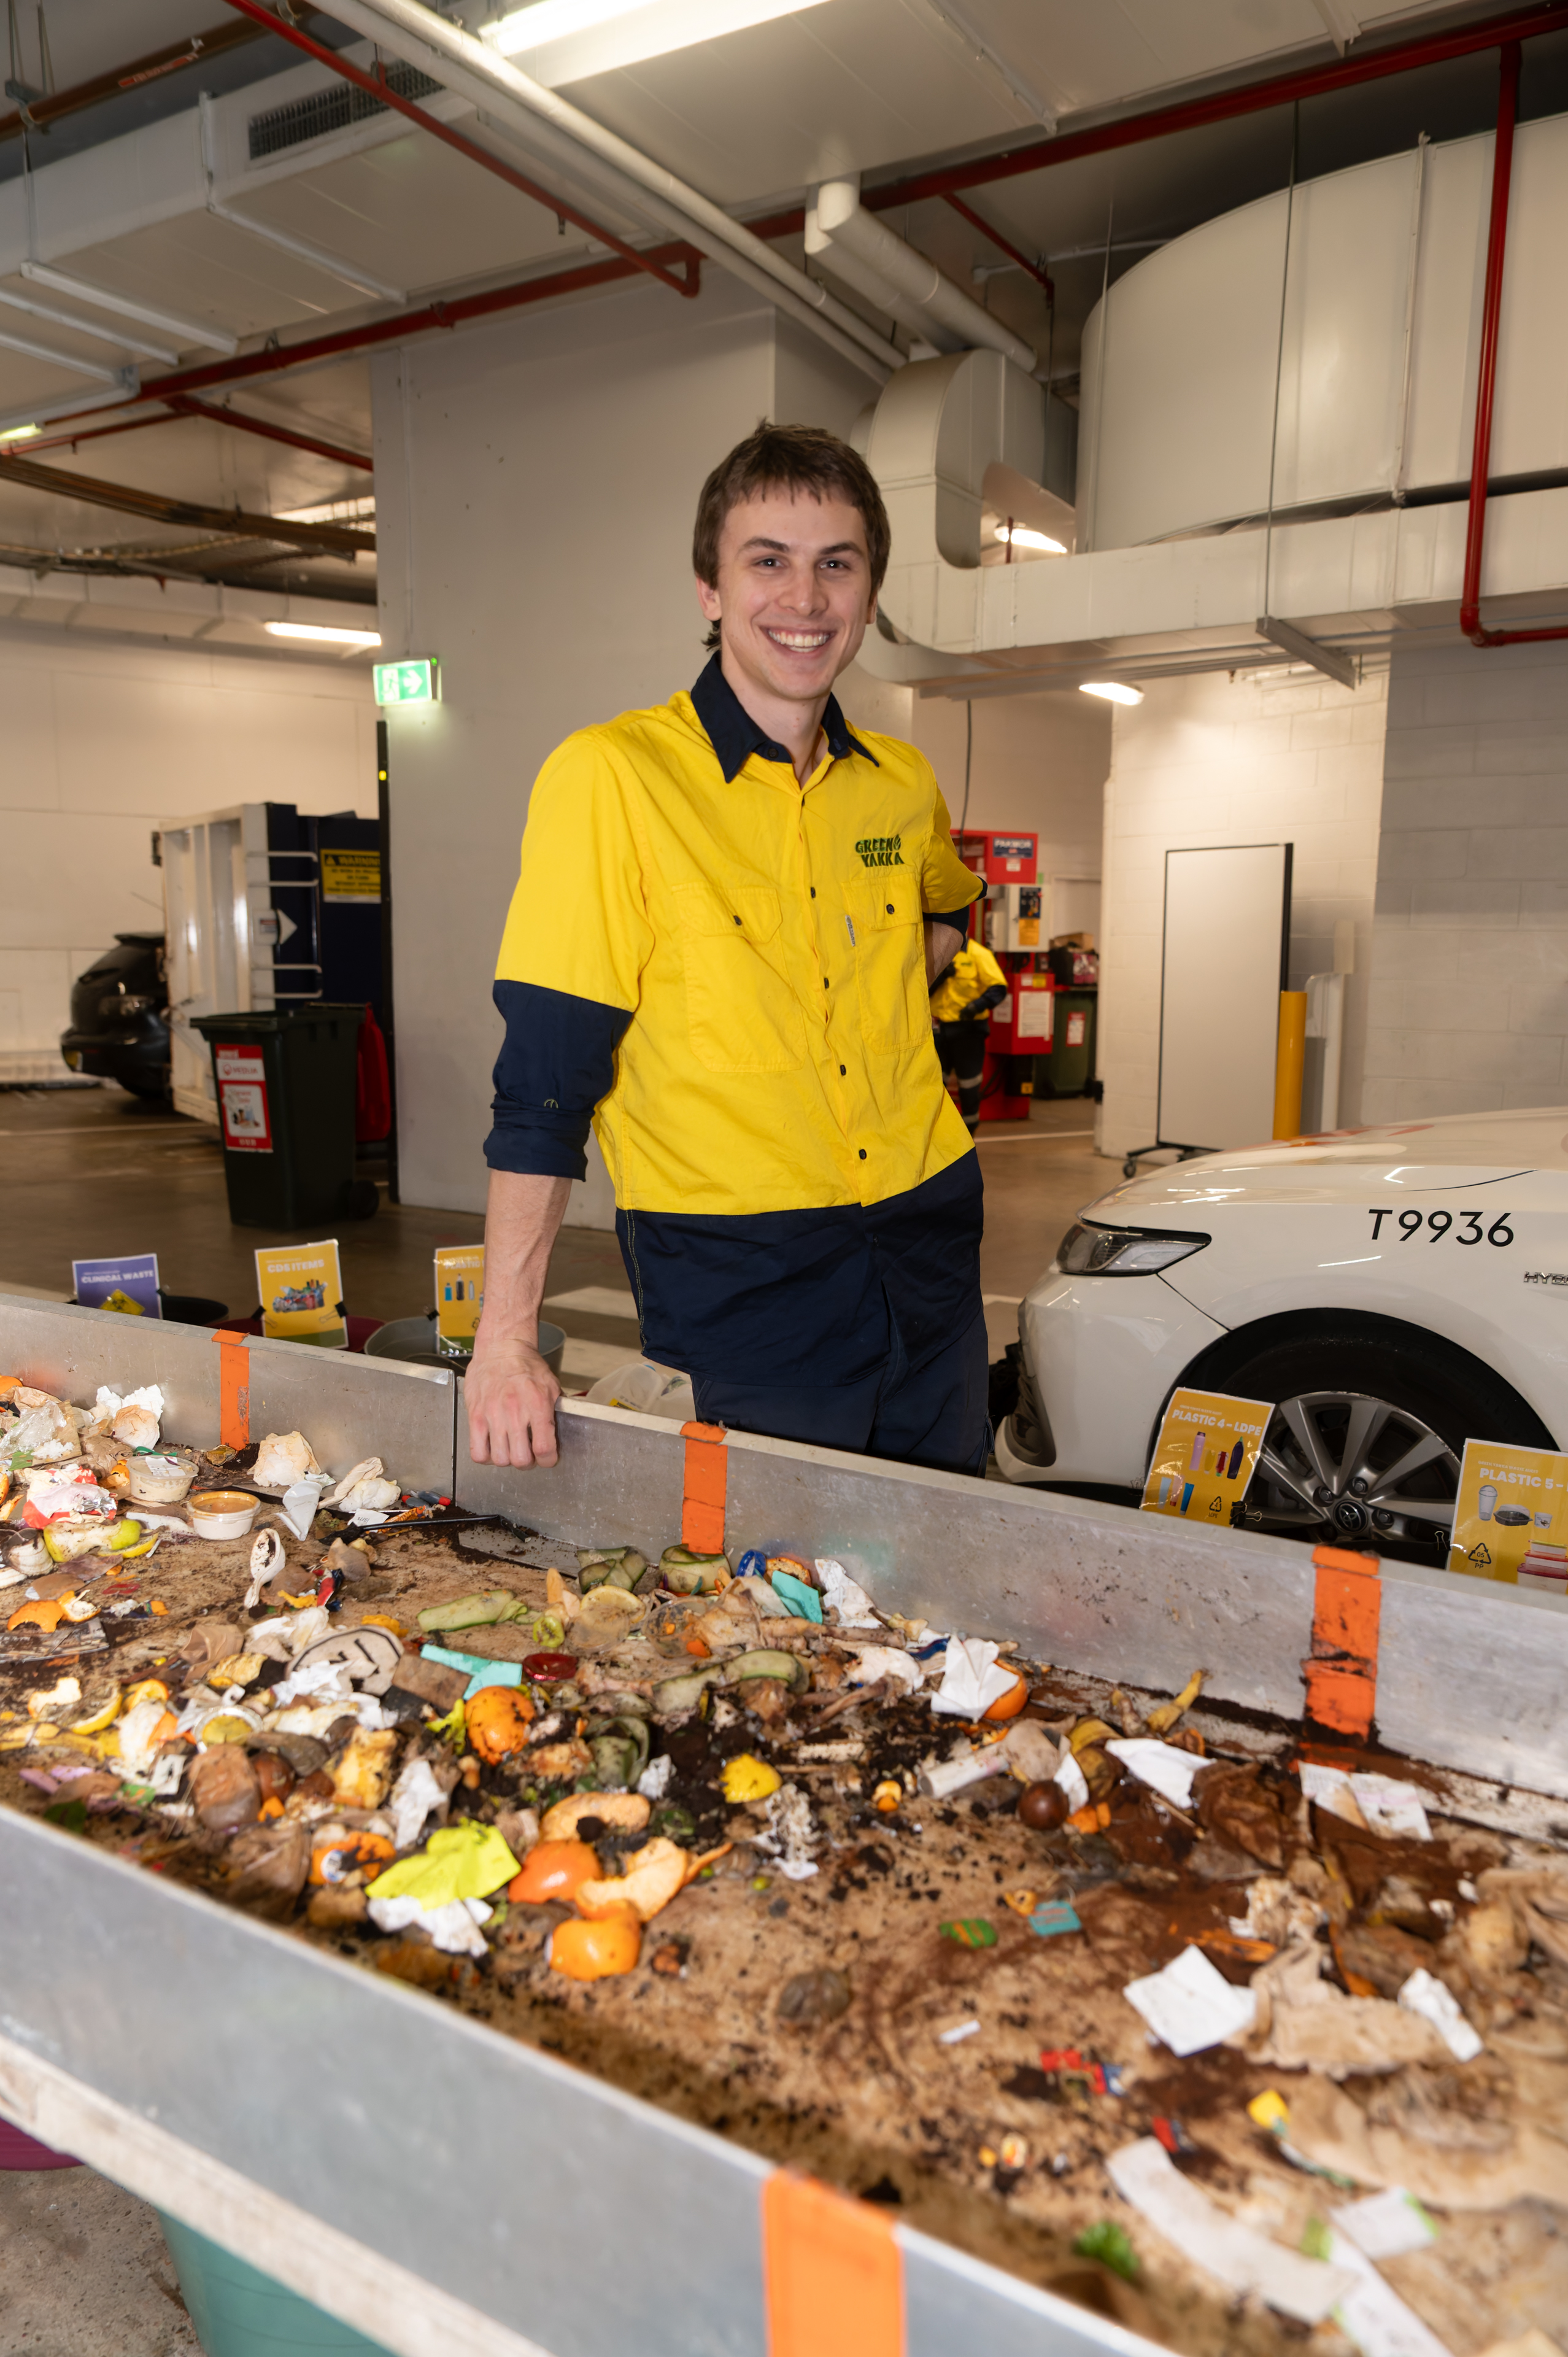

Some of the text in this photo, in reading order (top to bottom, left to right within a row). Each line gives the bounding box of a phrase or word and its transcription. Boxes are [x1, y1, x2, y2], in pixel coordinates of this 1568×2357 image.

[855, 838, 894, 854] GREEN
[861, 852, 905, 867] YAKKA
[1369, 1209, 1514, 1247] T9936
[268, 1263, 290, 1273] CDS
[292, 1259, 325, 1271] ITEMS
[81, 1274, 122, 1283] CLINICAL
[123, 1270, 153, 1280] WASTE
[1172, 1409, 1216, 1426] PLASTIC
[1217, 1418, 1226, 1428] 4
[1234, 1422, 1262, 1436] LDPE
[1480, 1468, 1542, 1487] PLASTIC
[1545, 1477, 1554, 1490] 5
